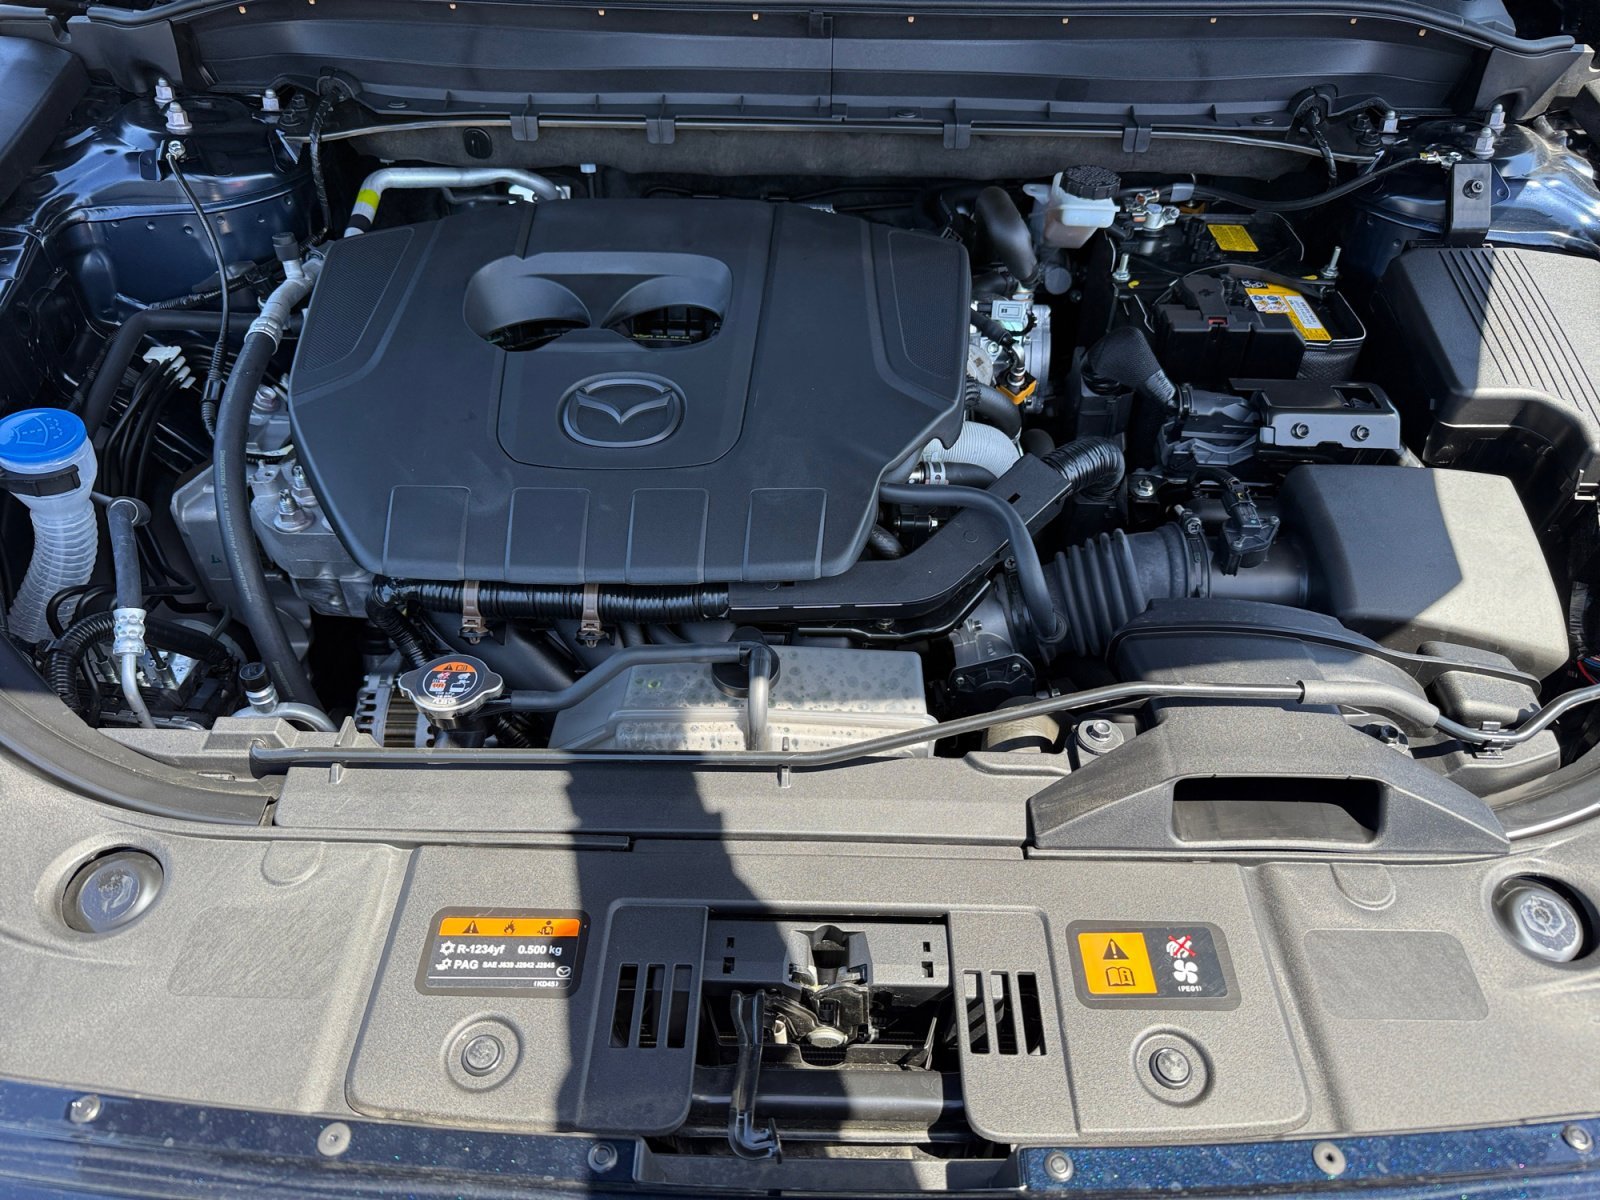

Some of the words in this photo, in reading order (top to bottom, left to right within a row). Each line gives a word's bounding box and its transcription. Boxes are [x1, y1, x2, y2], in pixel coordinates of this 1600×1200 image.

[456, 944, 506, 956] R-1234yf
[517, 945, 547, 954] 0.500
[549, 945, 562, 956] kg
[453, 960, 479, 969] PAG
